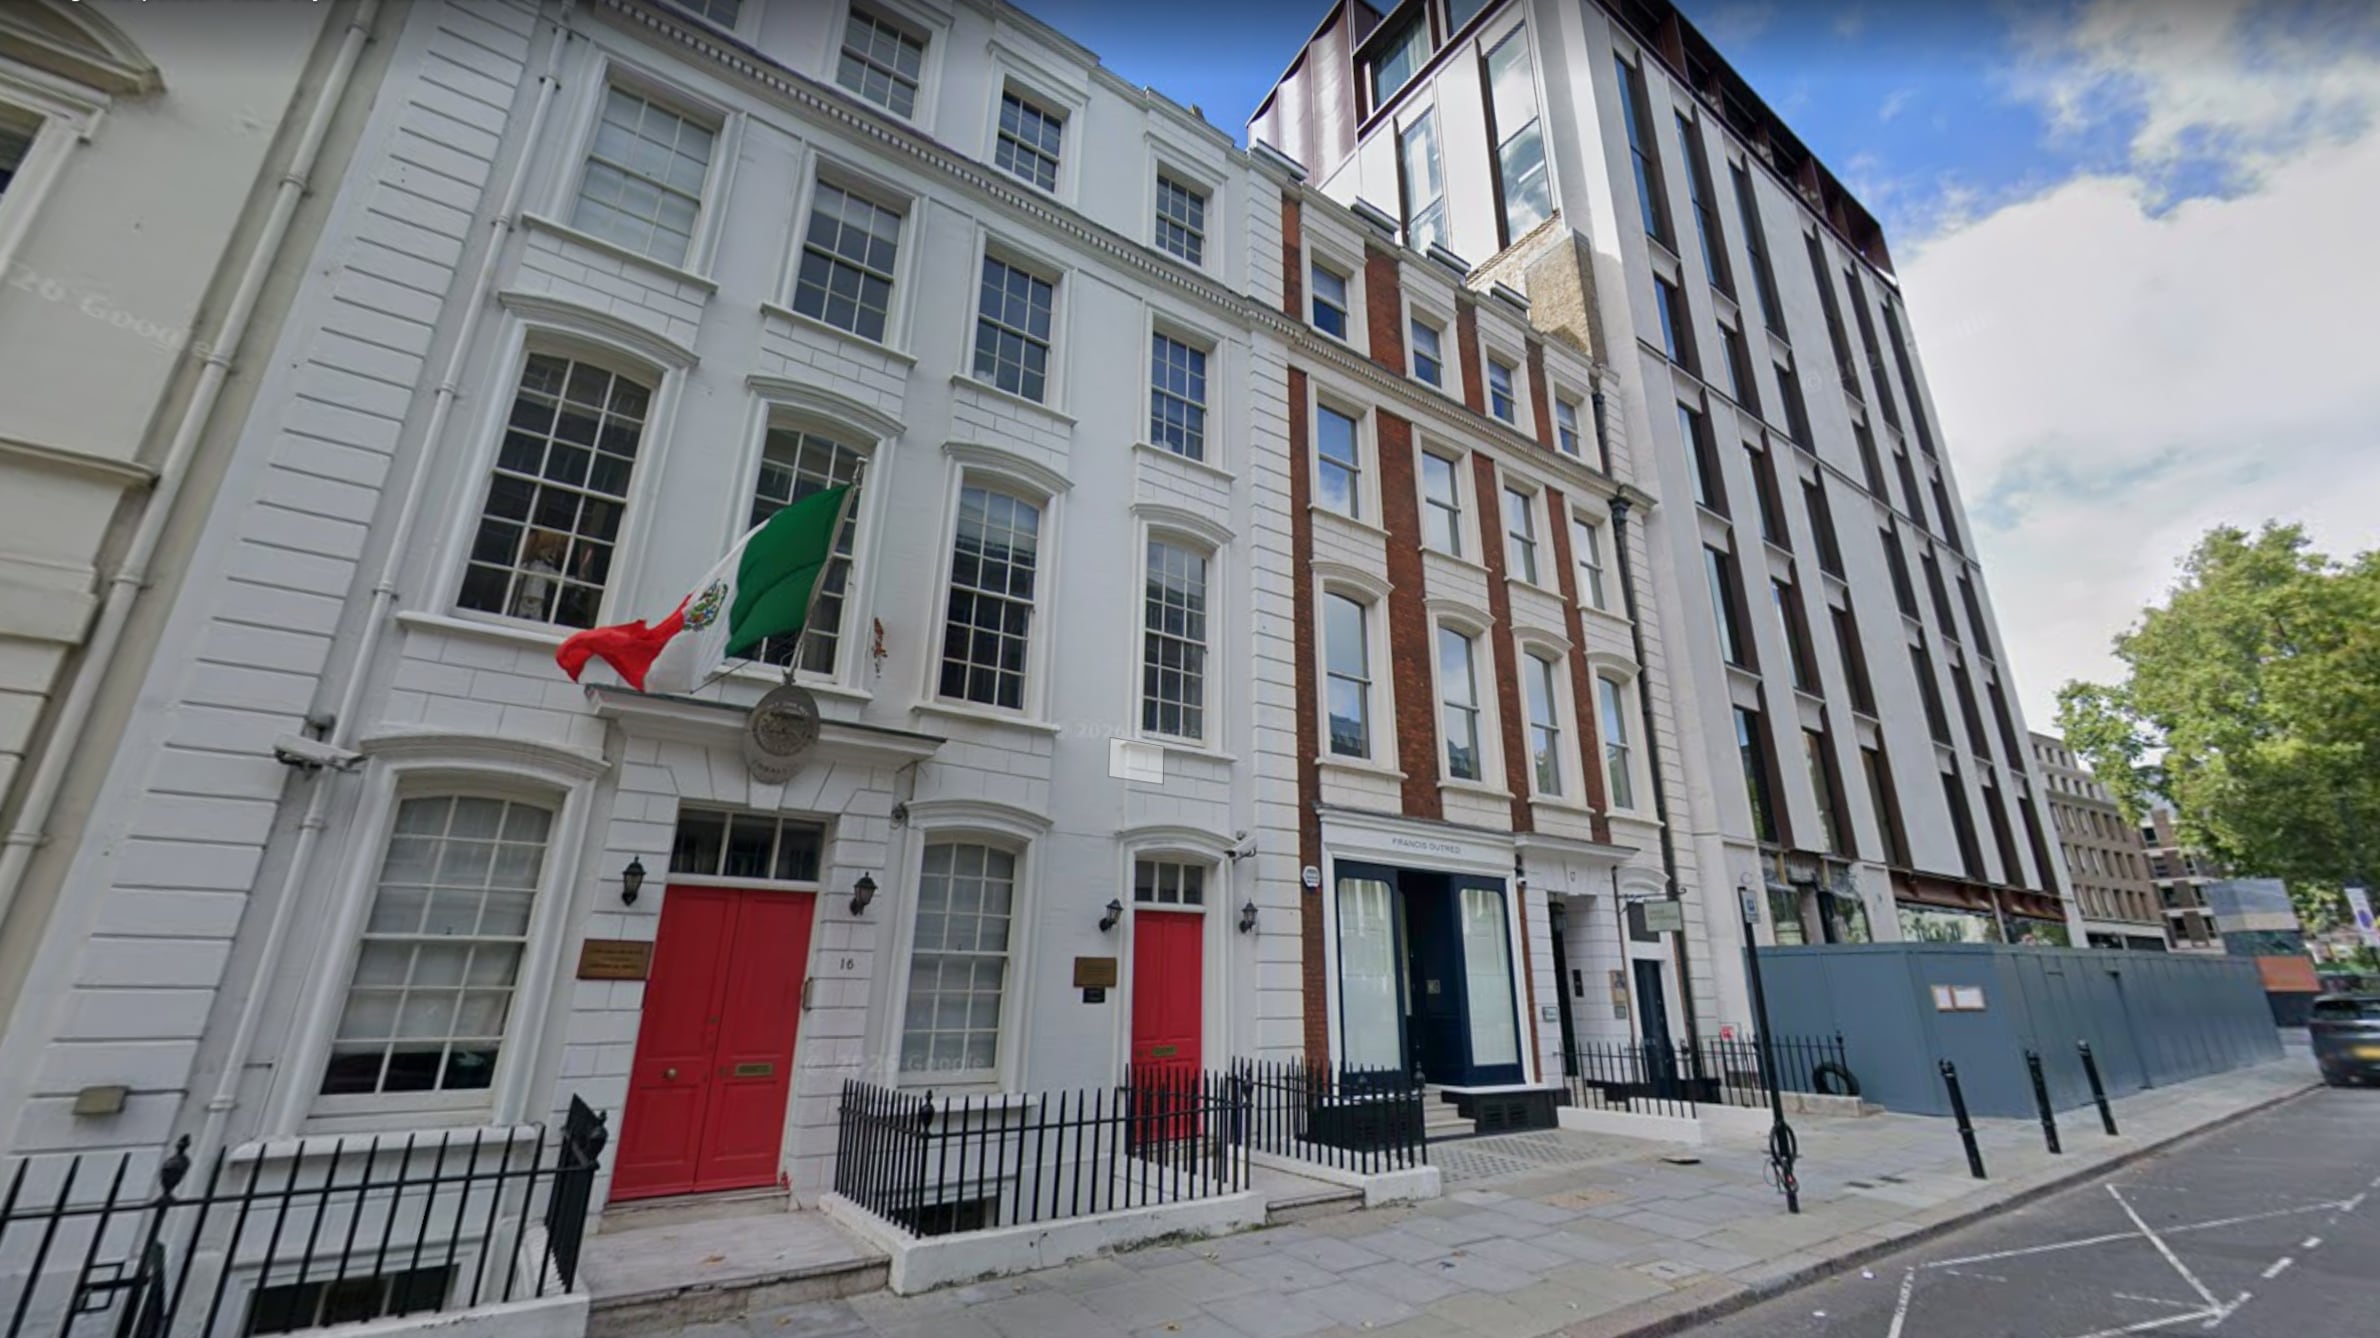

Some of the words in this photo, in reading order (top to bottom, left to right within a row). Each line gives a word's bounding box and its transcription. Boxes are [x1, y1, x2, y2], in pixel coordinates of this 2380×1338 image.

[1392, 838, 1427, 850] FRANCIS
[1428, 843, 1461, 854] OUTRED
[840, 958, 854, 970] 16
